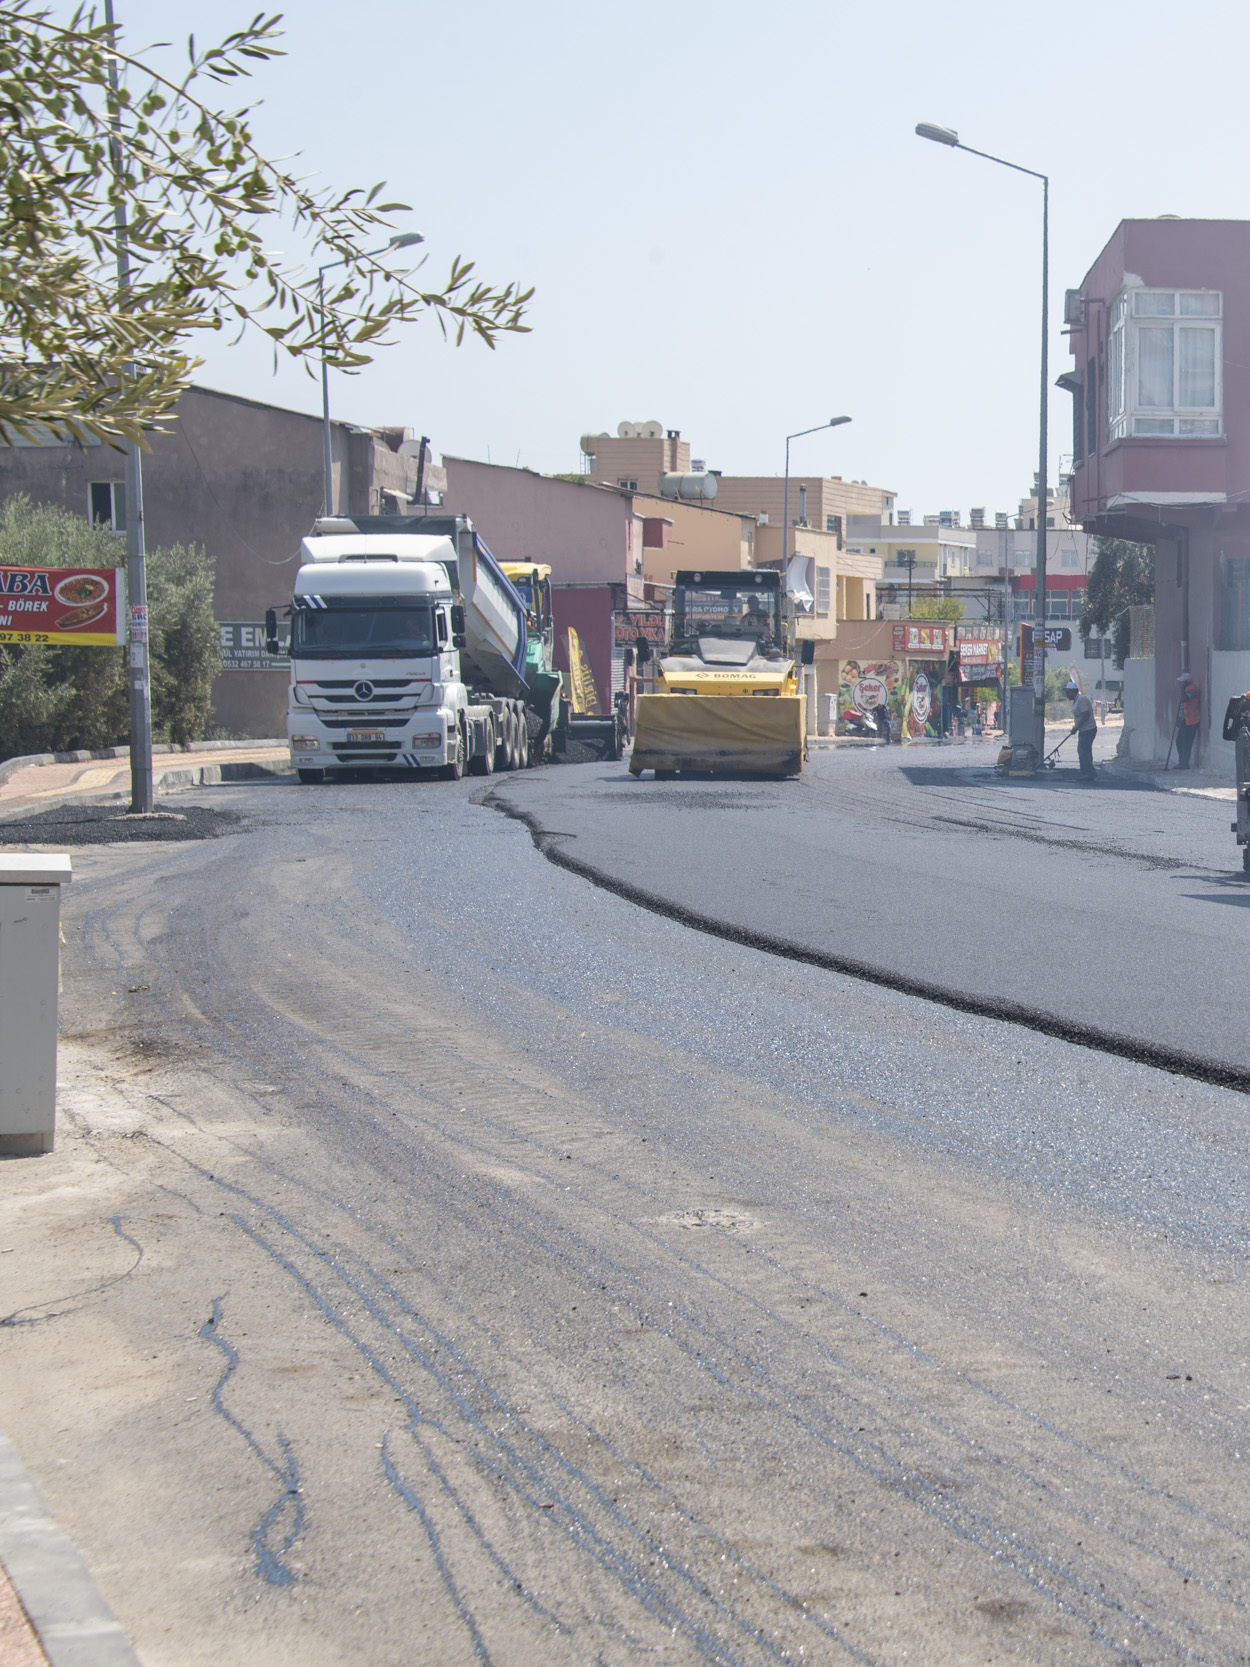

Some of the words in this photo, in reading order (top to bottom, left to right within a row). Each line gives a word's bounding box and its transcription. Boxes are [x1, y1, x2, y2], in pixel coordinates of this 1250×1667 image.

[8, 598, 49, 612] BÖREK
[17, 634, 31, 642] 38
[35, 634, 49, 643] 22
